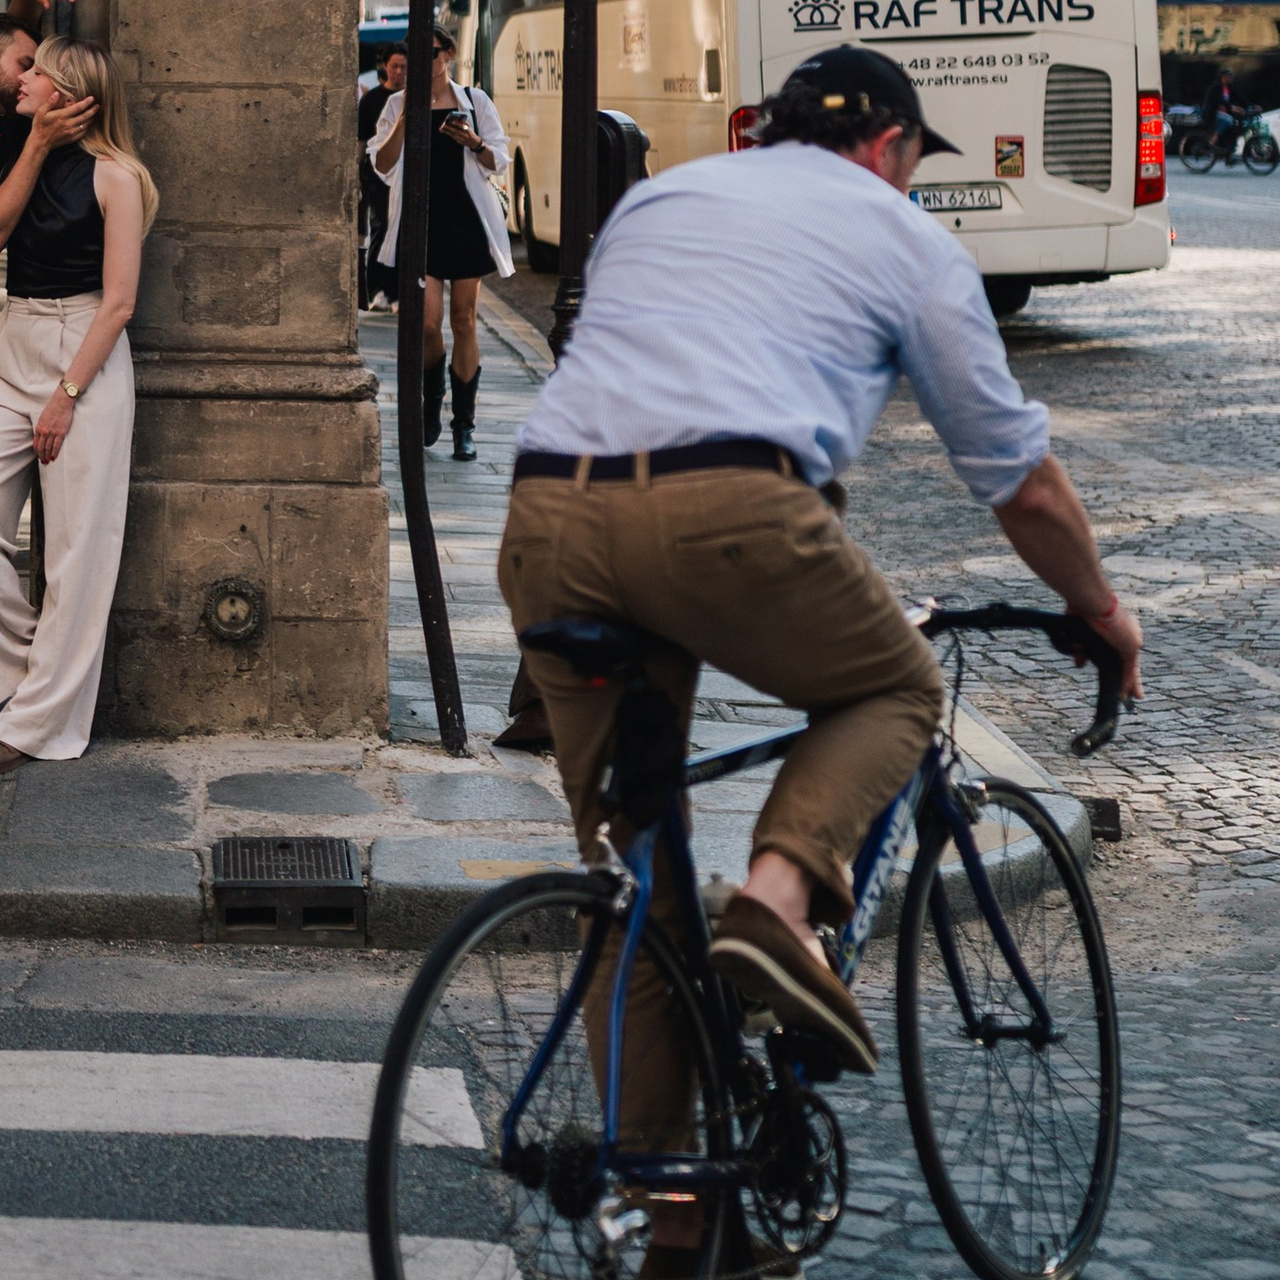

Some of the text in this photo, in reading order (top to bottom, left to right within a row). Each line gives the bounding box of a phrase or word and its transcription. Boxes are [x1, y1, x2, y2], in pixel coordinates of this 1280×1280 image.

[936, 57, 957, 69] 22
[963, 55, 997, 69] 648
[1001, 54, 1023, 67] 03
[1028, 52, 1050, 65] 52
[526, 49, 564, 90] RAF TRA
[908, 74, 1008, 88] w.raftrans.eu
[921, 191, 997, 208] WN 6216L
